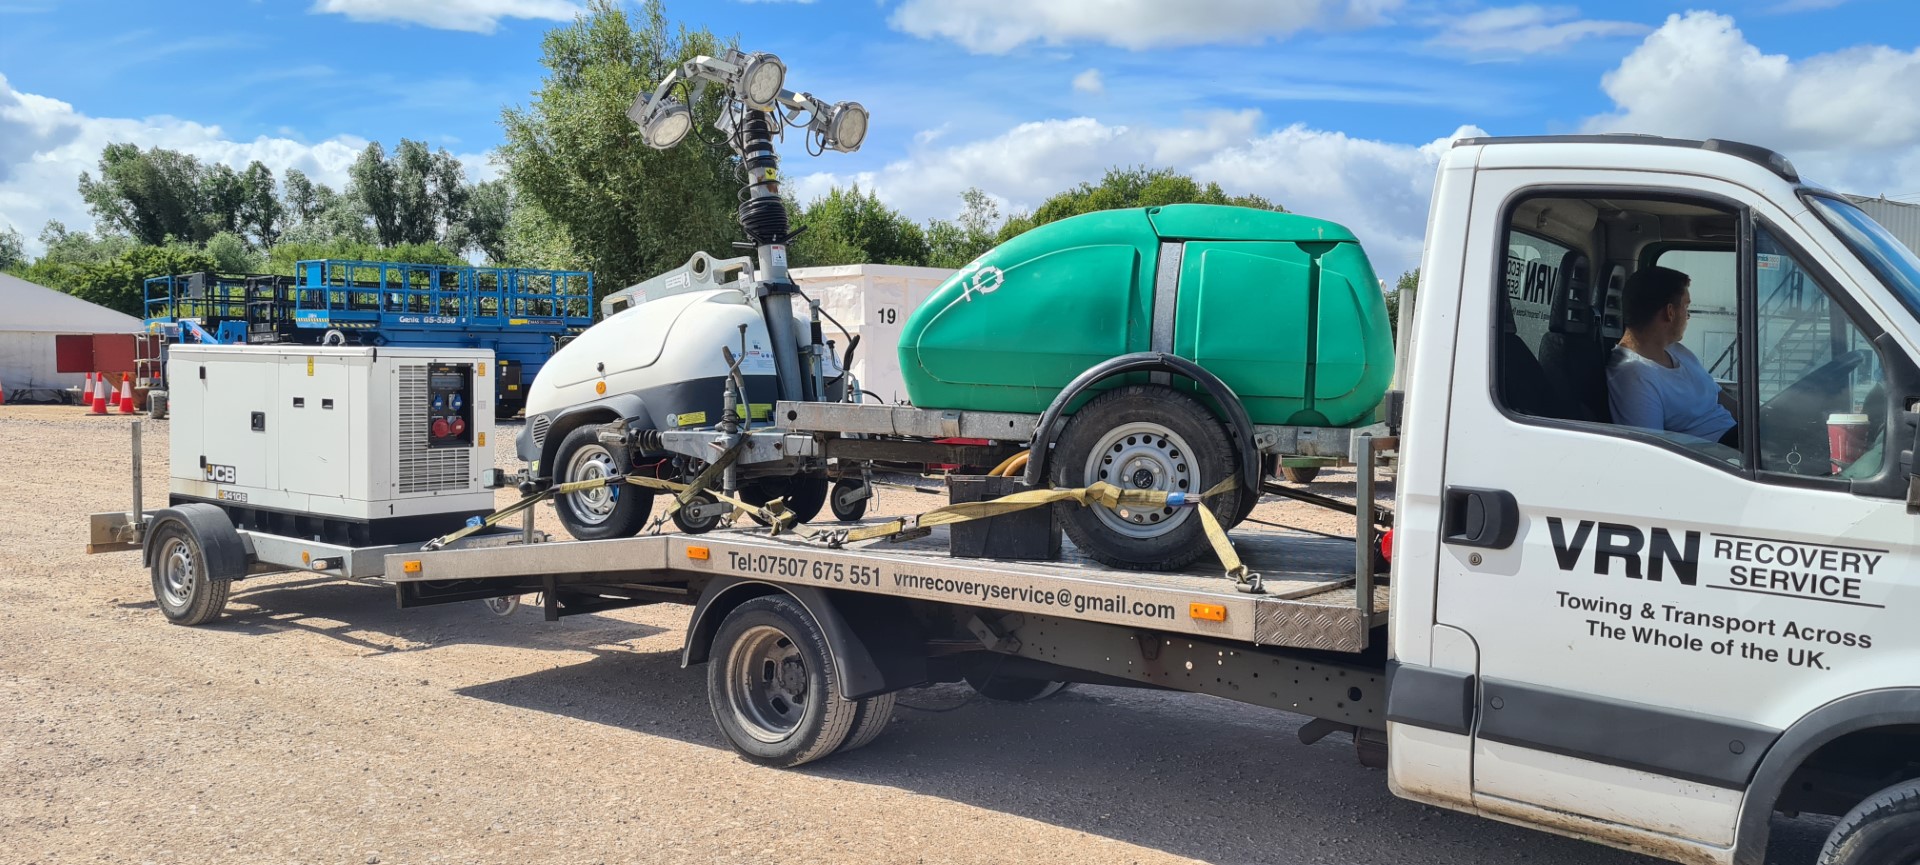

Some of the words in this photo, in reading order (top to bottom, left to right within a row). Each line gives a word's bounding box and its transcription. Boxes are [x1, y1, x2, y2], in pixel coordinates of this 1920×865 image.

[399, 315, 420, 324] Genie
[423, 316, 457, 325] GS-5390
[877, 307, 897, 325] 19
[207, 464, 236, 483] JCB
[387, 503, 394, 516] 1
[1546, 516, 1701, 587] VRN
[1713, 539, 1884, 576] RECOVERY
[728, 551, 808, 578] Tel:07507
[812, 560, 845, 583] 675
[849, 565, 881, 587] 551
[893, 572, 1177, 620] vrnrecoveryservice@gmail.com
[1728, 566, 1862, 600] SERVICE
[1556, 591, 1633, 621] Towing
[1640, 602, 1656, 621] &
[1662, 604, 1777, 637] Transport
[1782, 621, 1873, 649] Across
[1586, 619, 1627, 641] The
[1631, 625, 1703, 652] Whole
[1710, 637, 1734, 658] of
[1740, 641, 1779, 663] the
[1787, 648, 1832, 671] UK.
